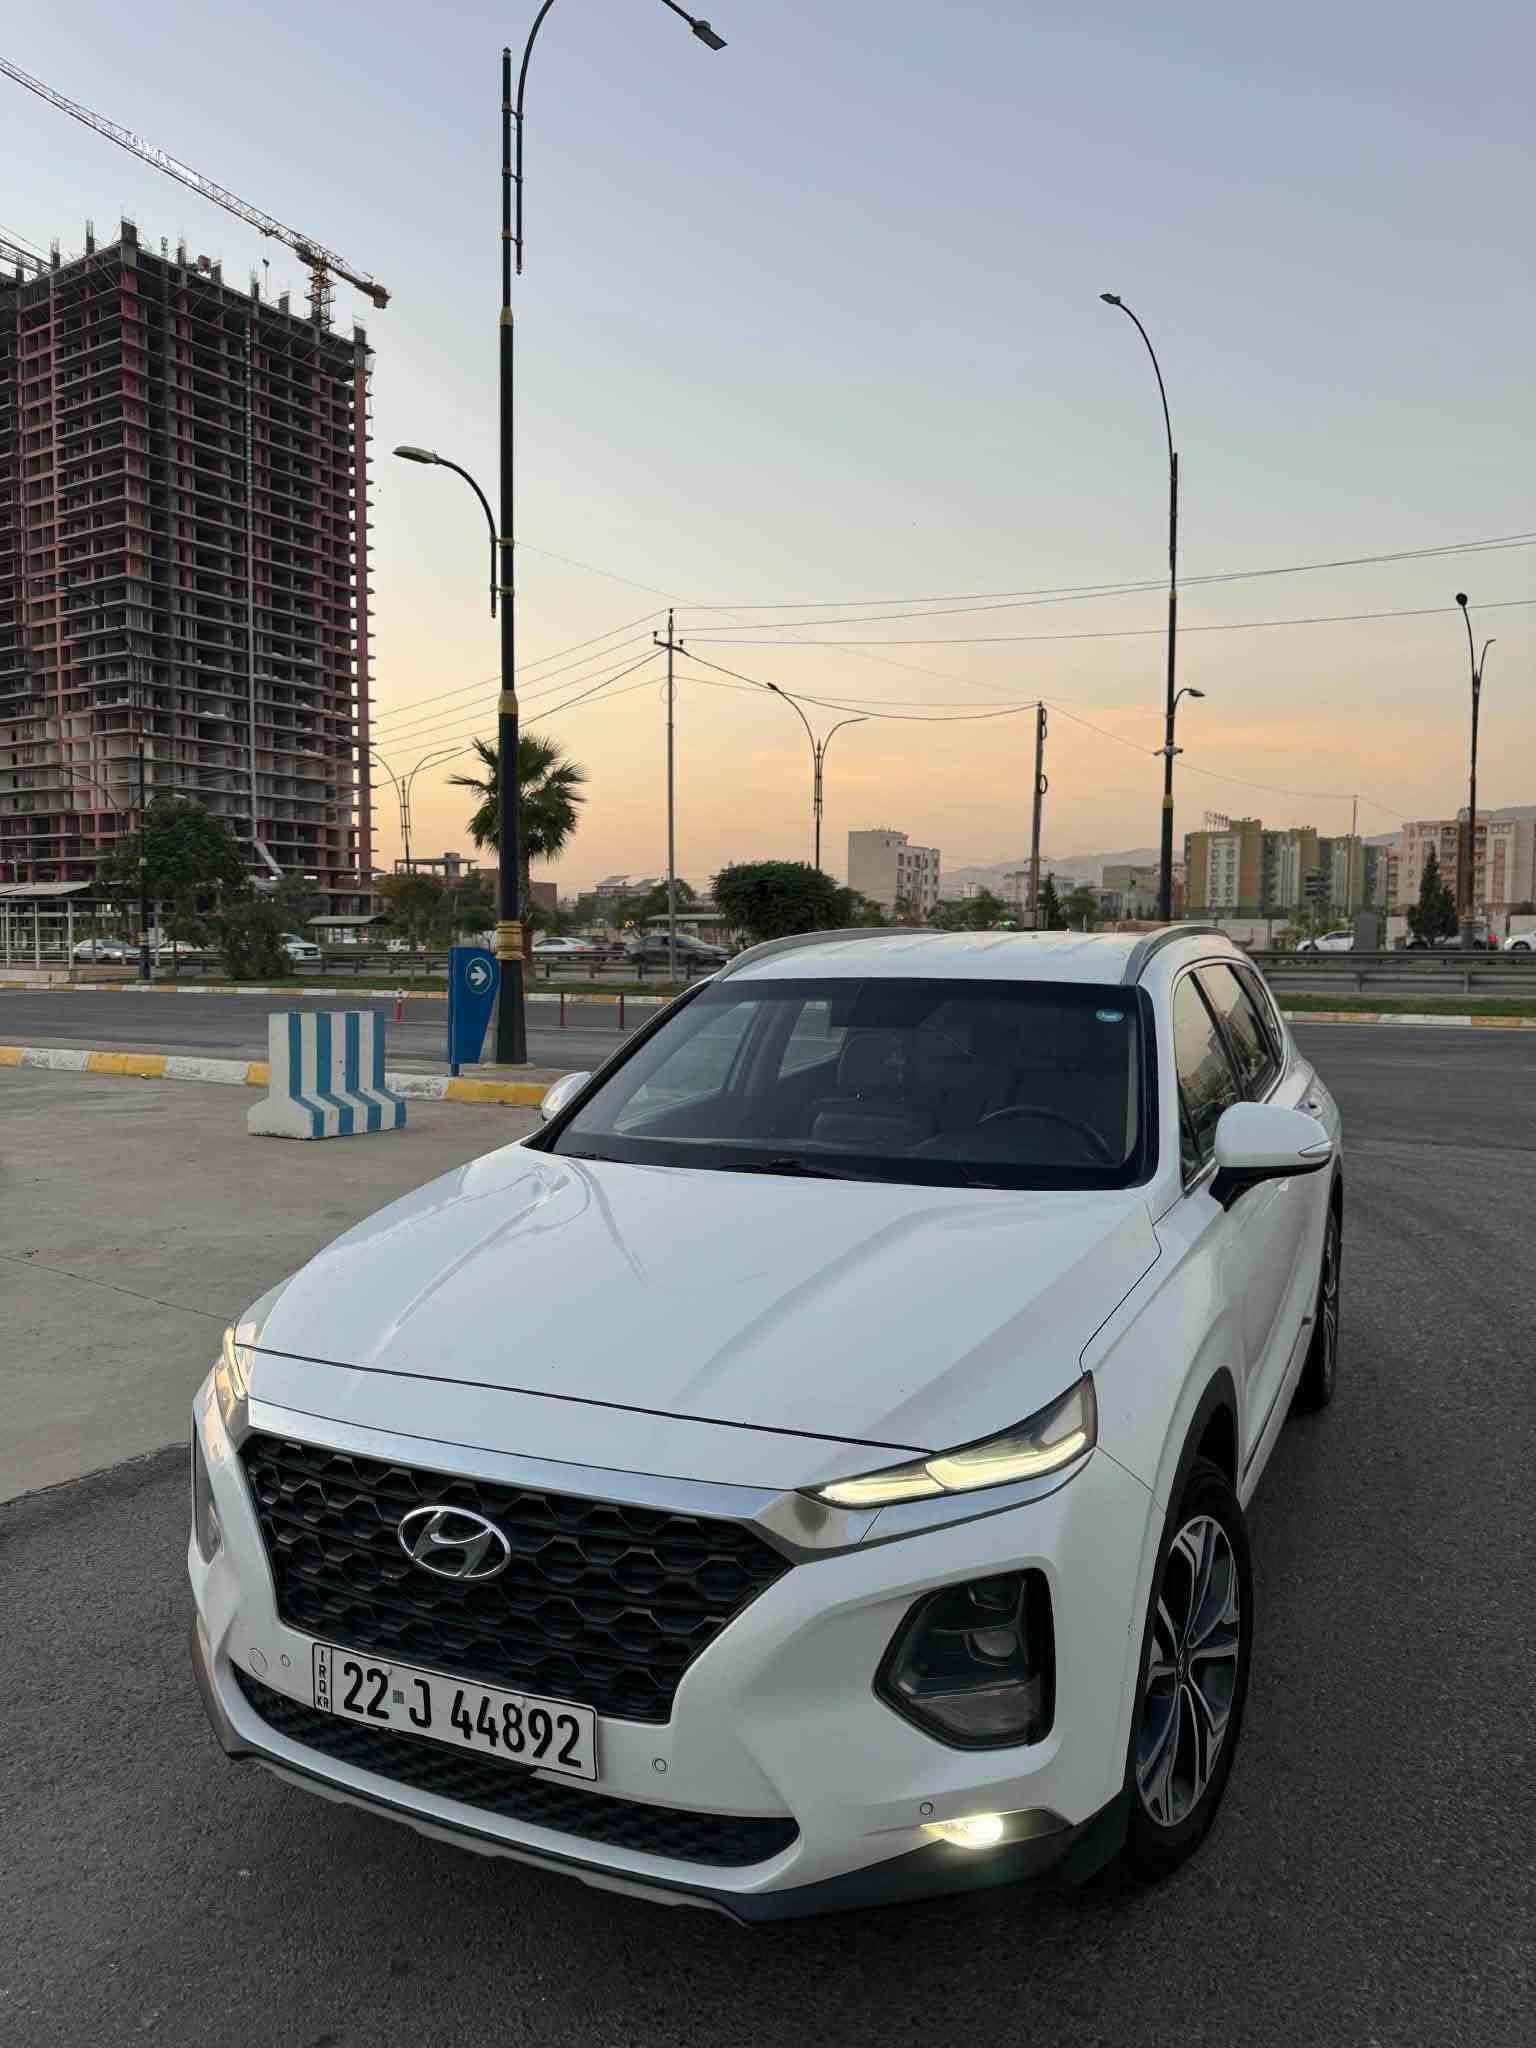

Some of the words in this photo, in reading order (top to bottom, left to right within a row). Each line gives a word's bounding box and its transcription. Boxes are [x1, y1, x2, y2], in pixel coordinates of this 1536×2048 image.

[343, 1661, 389, 1720] 22
[409, 1678, 432, 1729] J
[450, 1689, 582, 1769] 44892
